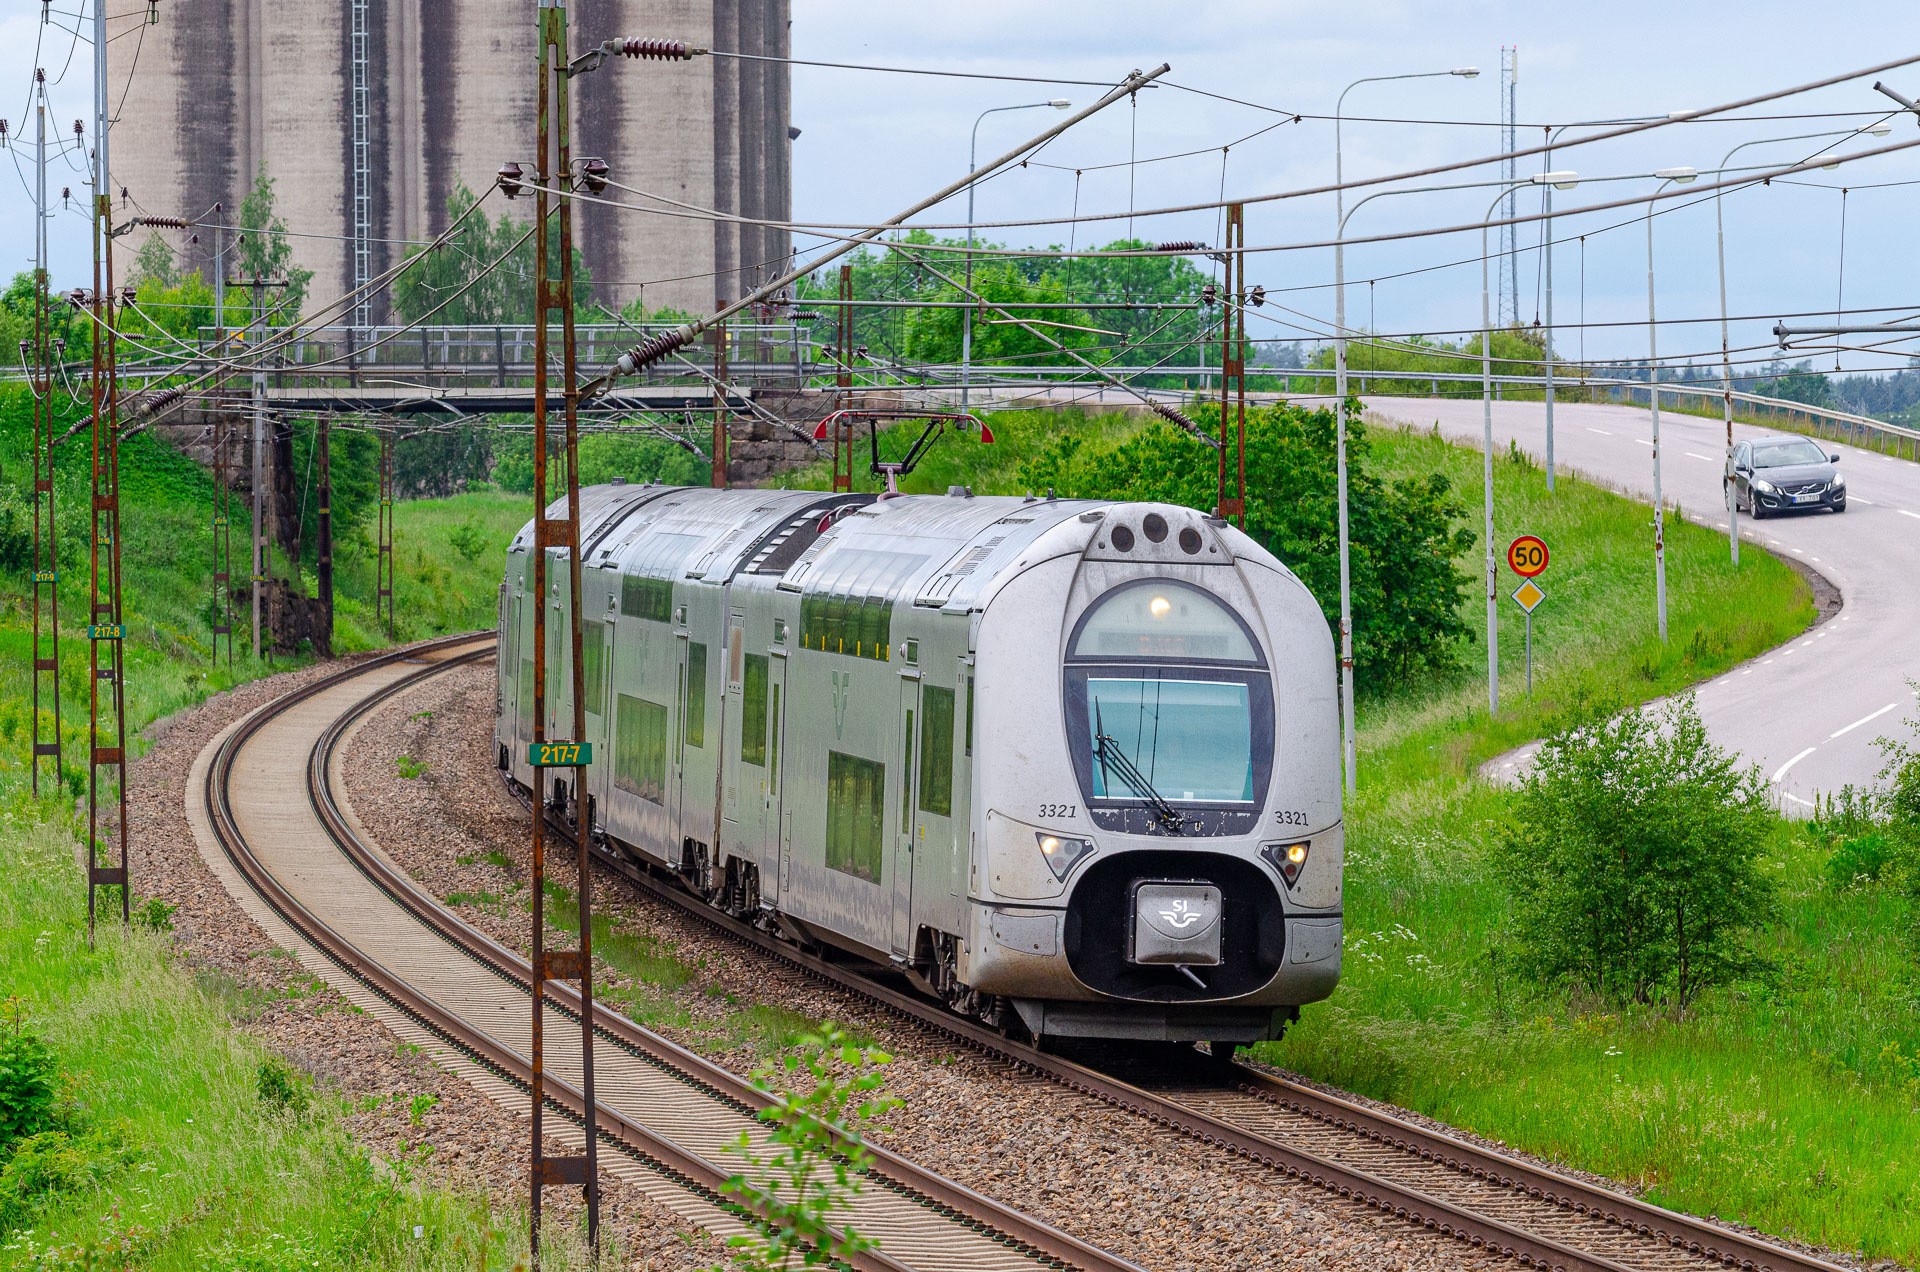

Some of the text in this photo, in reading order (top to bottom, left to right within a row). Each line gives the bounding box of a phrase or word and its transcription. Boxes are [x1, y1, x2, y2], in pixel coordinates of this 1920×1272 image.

[1515, 546, 1543, 567] 50
[36, 573, 54, 581] 217-9
[94, 626, 120, 638] 217-8
[540, 745, 580, 763] 217-7
[1038, 804, 1076, 818] 3321
[1274, 810, 1309, 826] 3321
[1172, 899, 1188, 913] SJ
